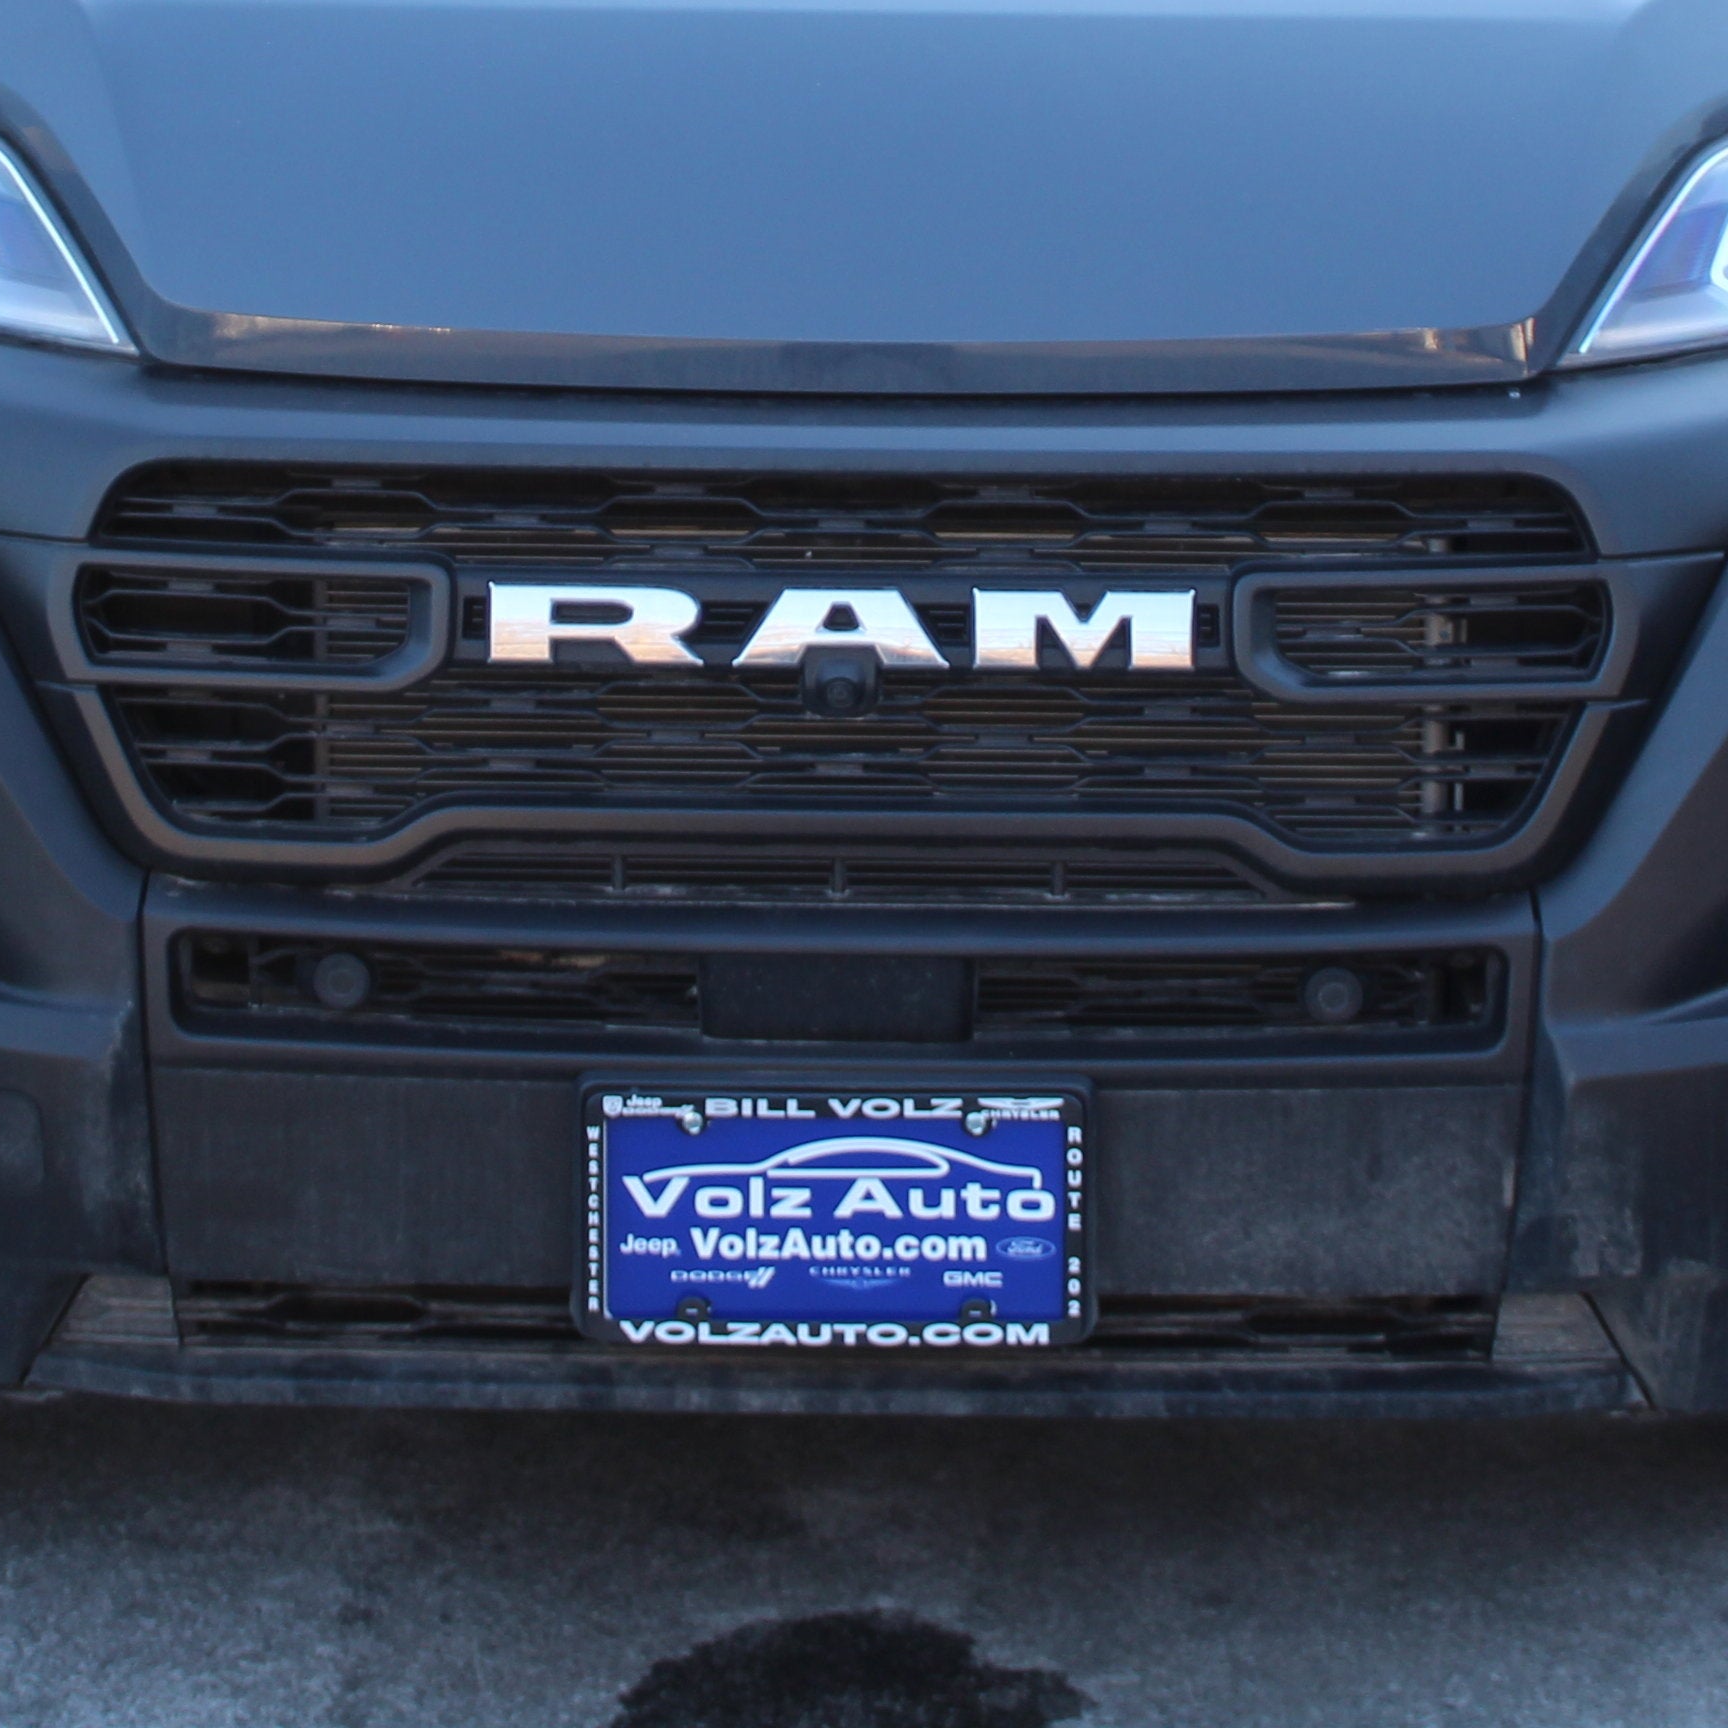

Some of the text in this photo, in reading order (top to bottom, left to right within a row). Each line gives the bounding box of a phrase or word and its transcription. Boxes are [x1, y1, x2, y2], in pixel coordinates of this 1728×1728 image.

[488, 582, 1196, 671] RAM
[705, 1097, 816, 1118] BILL
[828, 1097, 962, 1119] VOLZ
[622, 1176, 1056, 1221] Volz Auto
[587, 1126, 600, 1312] WESTCHESTER
[1067, 1127, 1083, 1317] ROUTE 202
[620, 1233, 677, 1259] Jeep
[690, 1227, 987, 1261] VolzAuto.com
[809, 1266, 911, 1277] CHRYSLER
[943, 1271, 1003, 1288] GMC
[619, 1320, 1050, 1347] VOLZAUTO.COM
